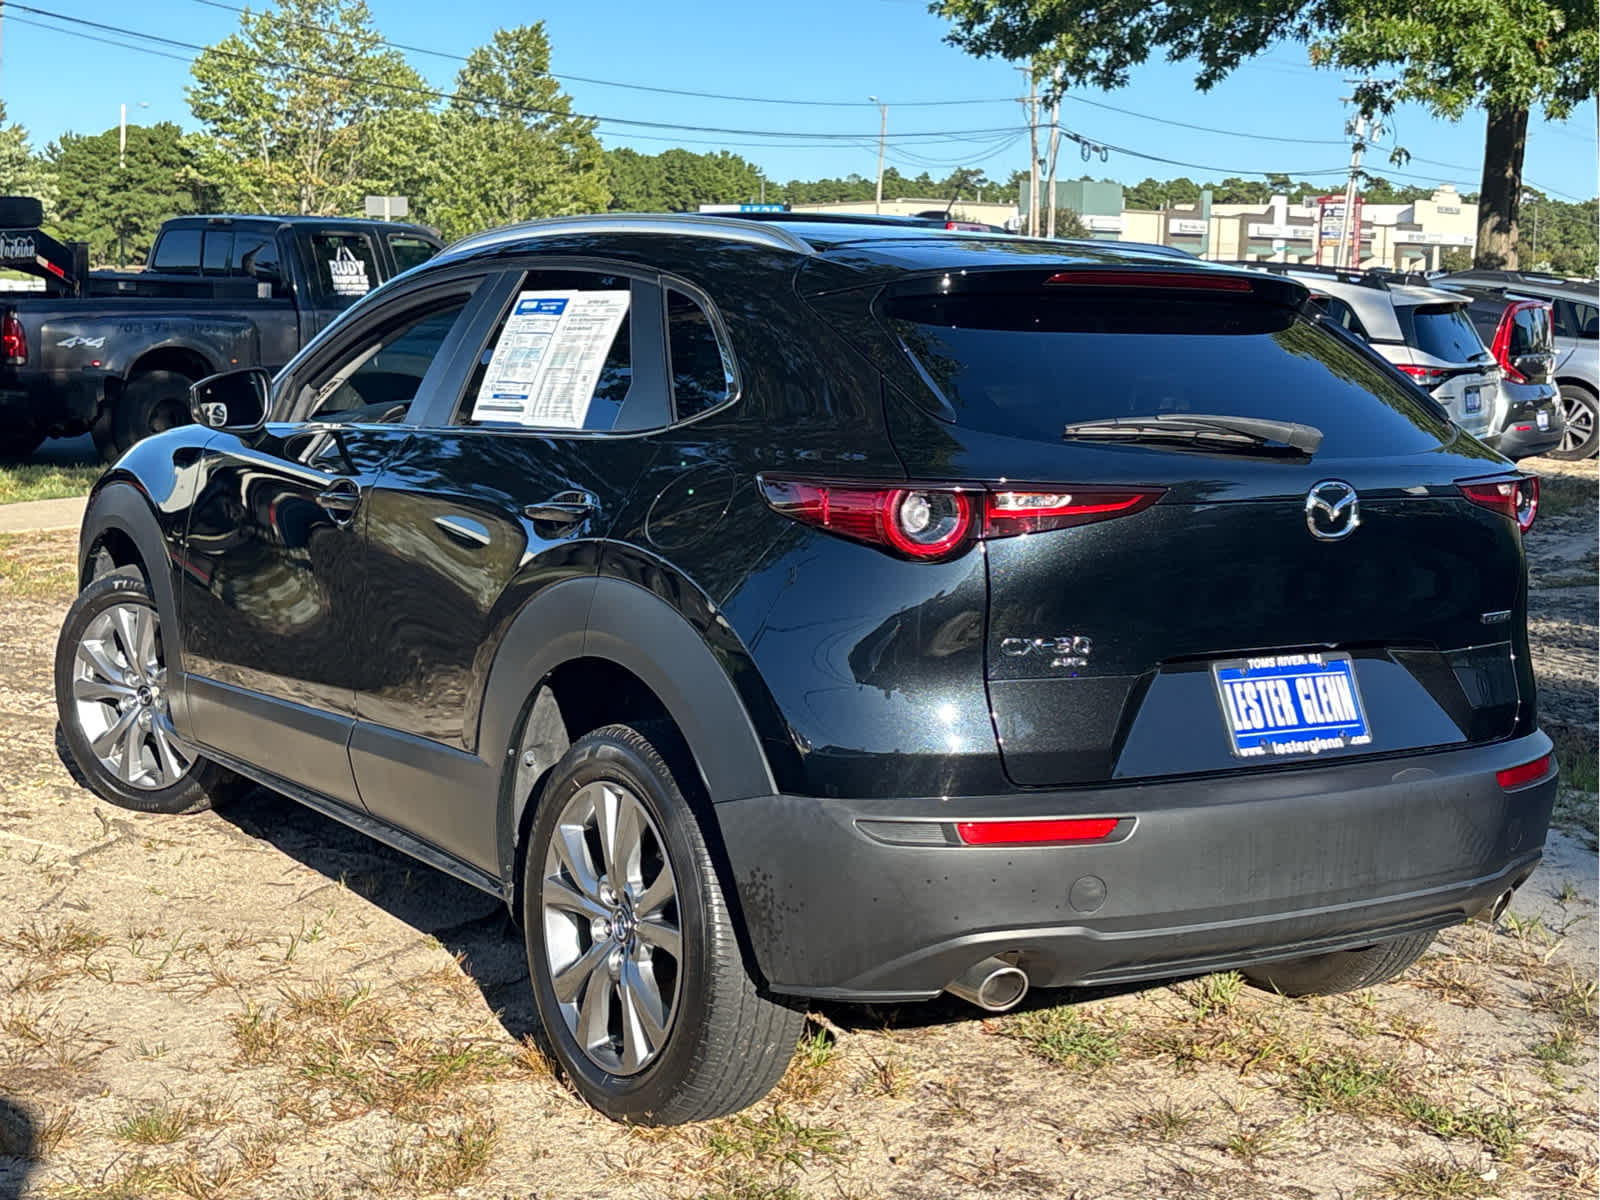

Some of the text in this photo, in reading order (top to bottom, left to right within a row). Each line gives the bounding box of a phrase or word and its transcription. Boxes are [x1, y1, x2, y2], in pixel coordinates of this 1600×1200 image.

[328, 259, 365, 275] RUDY
[1000, 636, 1093, 656] CX-30
[1247, 657, 1275, 669] TOMS
[1308, 653, 1321, 664] NJ
[1224, 674, 1358, 731] LESTER GLENN
[1272, 736, 1344, 754] lesterglenn
